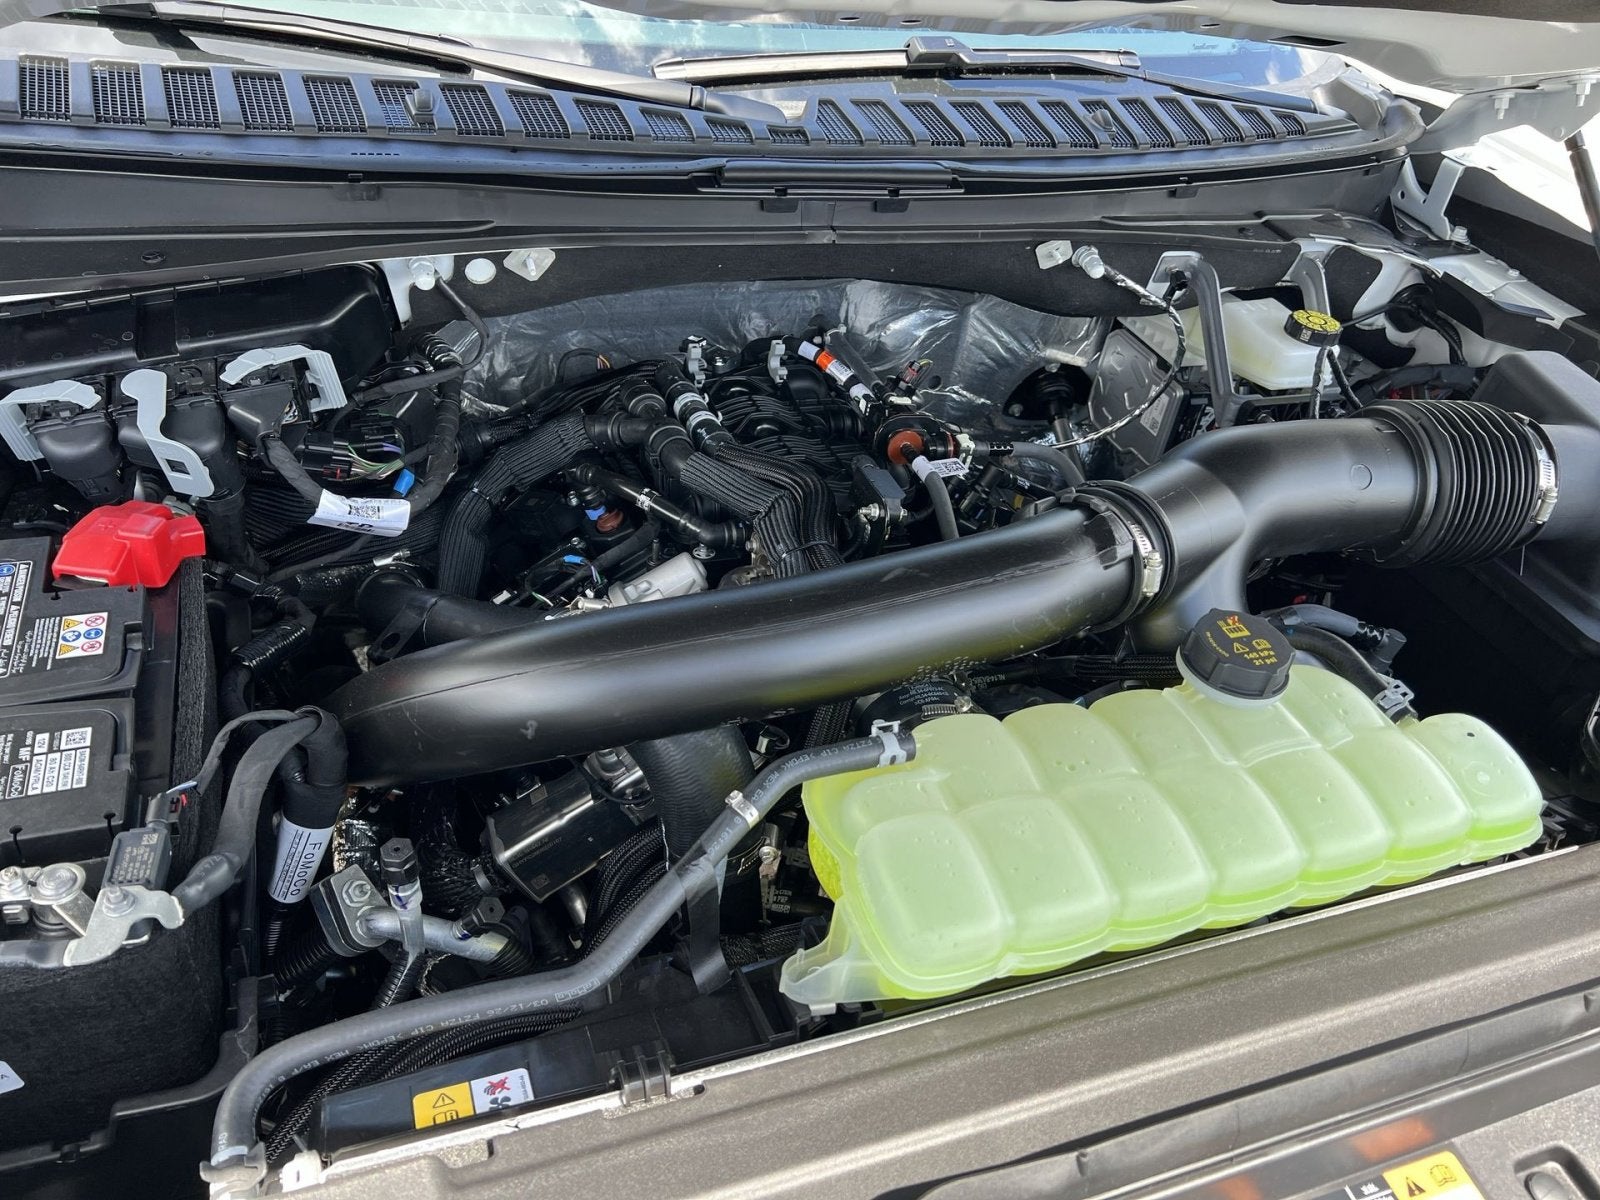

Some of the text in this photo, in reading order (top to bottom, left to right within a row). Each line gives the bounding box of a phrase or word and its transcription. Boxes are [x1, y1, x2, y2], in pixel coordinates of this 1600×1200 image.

[38, 738, 46, 749] 12V
[18, 747, 31, 761] MF
[10, 766, 25, 797] FoMoCo
[290, 842, 322, 896] FoMoCo
[324, 1049, 350, 1062] MEX
